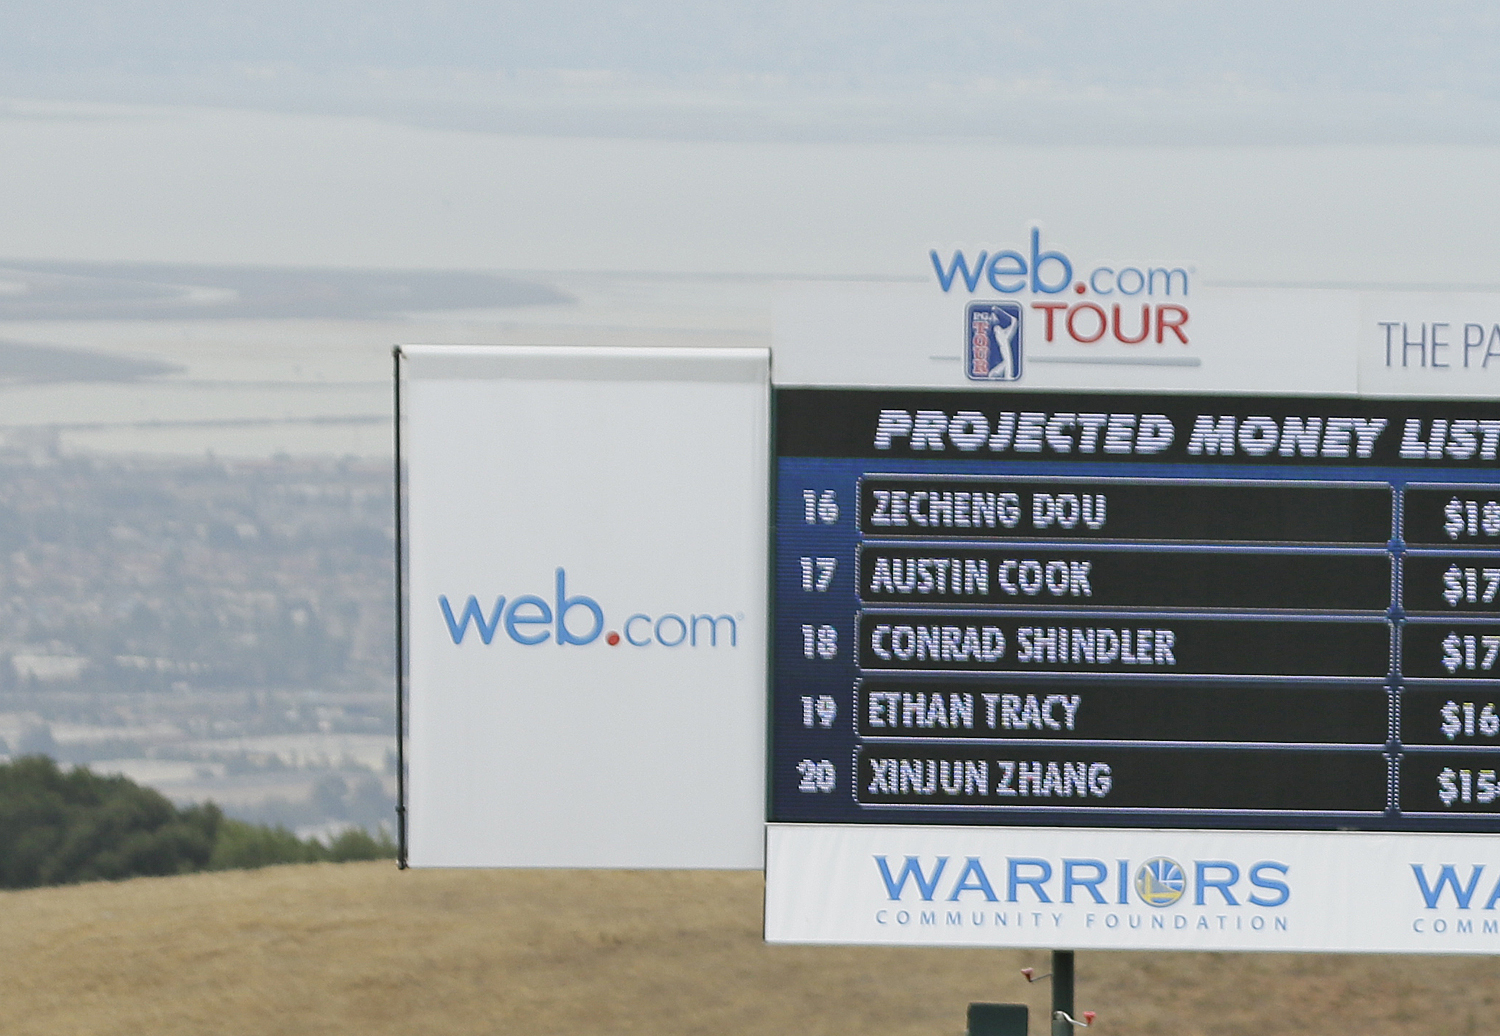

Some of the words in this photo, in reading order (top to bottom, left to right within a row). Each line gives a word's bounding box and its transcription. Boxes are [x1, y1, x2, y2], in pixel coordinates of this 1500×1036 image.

[929, 227, 1190, 296] web.com
[973, 312, 999, 321] PGA
[1031, 302, 1190, 345] TOUR
[972, 321, 989, 376] TOUR
[1378, 322, 1450, 368] THE
[874, 410, 1175, 454] PROJECTED
[1187, 414, 1389, 458] MONEY
[802, 490, 840, 525] 16
[870, 490, 1021, 528] ZECHENG
[1032, 493, 1106, 529] DOU
[799, 557, 838, 593] 17
[870, 557, 989, 595] AUSTIN
[998, 560, 1092, 597] COOK
[437, 566, 736, 647] web.com
[800, 624, 838, 659] 18
[870, 624, 1006, 662] CONRAD
[1017, 626, 1177, 665] SHINDLER
[799, 695, 837, 729] 19
[868, 691, 974, 728] ETHAN
[981, 692, 1081, 731] TRACY
[797, 758, 836, 794] 20
[868, 759, 989, 797] XINJUN
[996, 760, 1113, 798] ZHANG
[873, 855, 1291, 908] WARRIORS
[876, 909, 1064, 928] COMMUNITY
[1086, 913, 1289, 932] FOUNDATION
